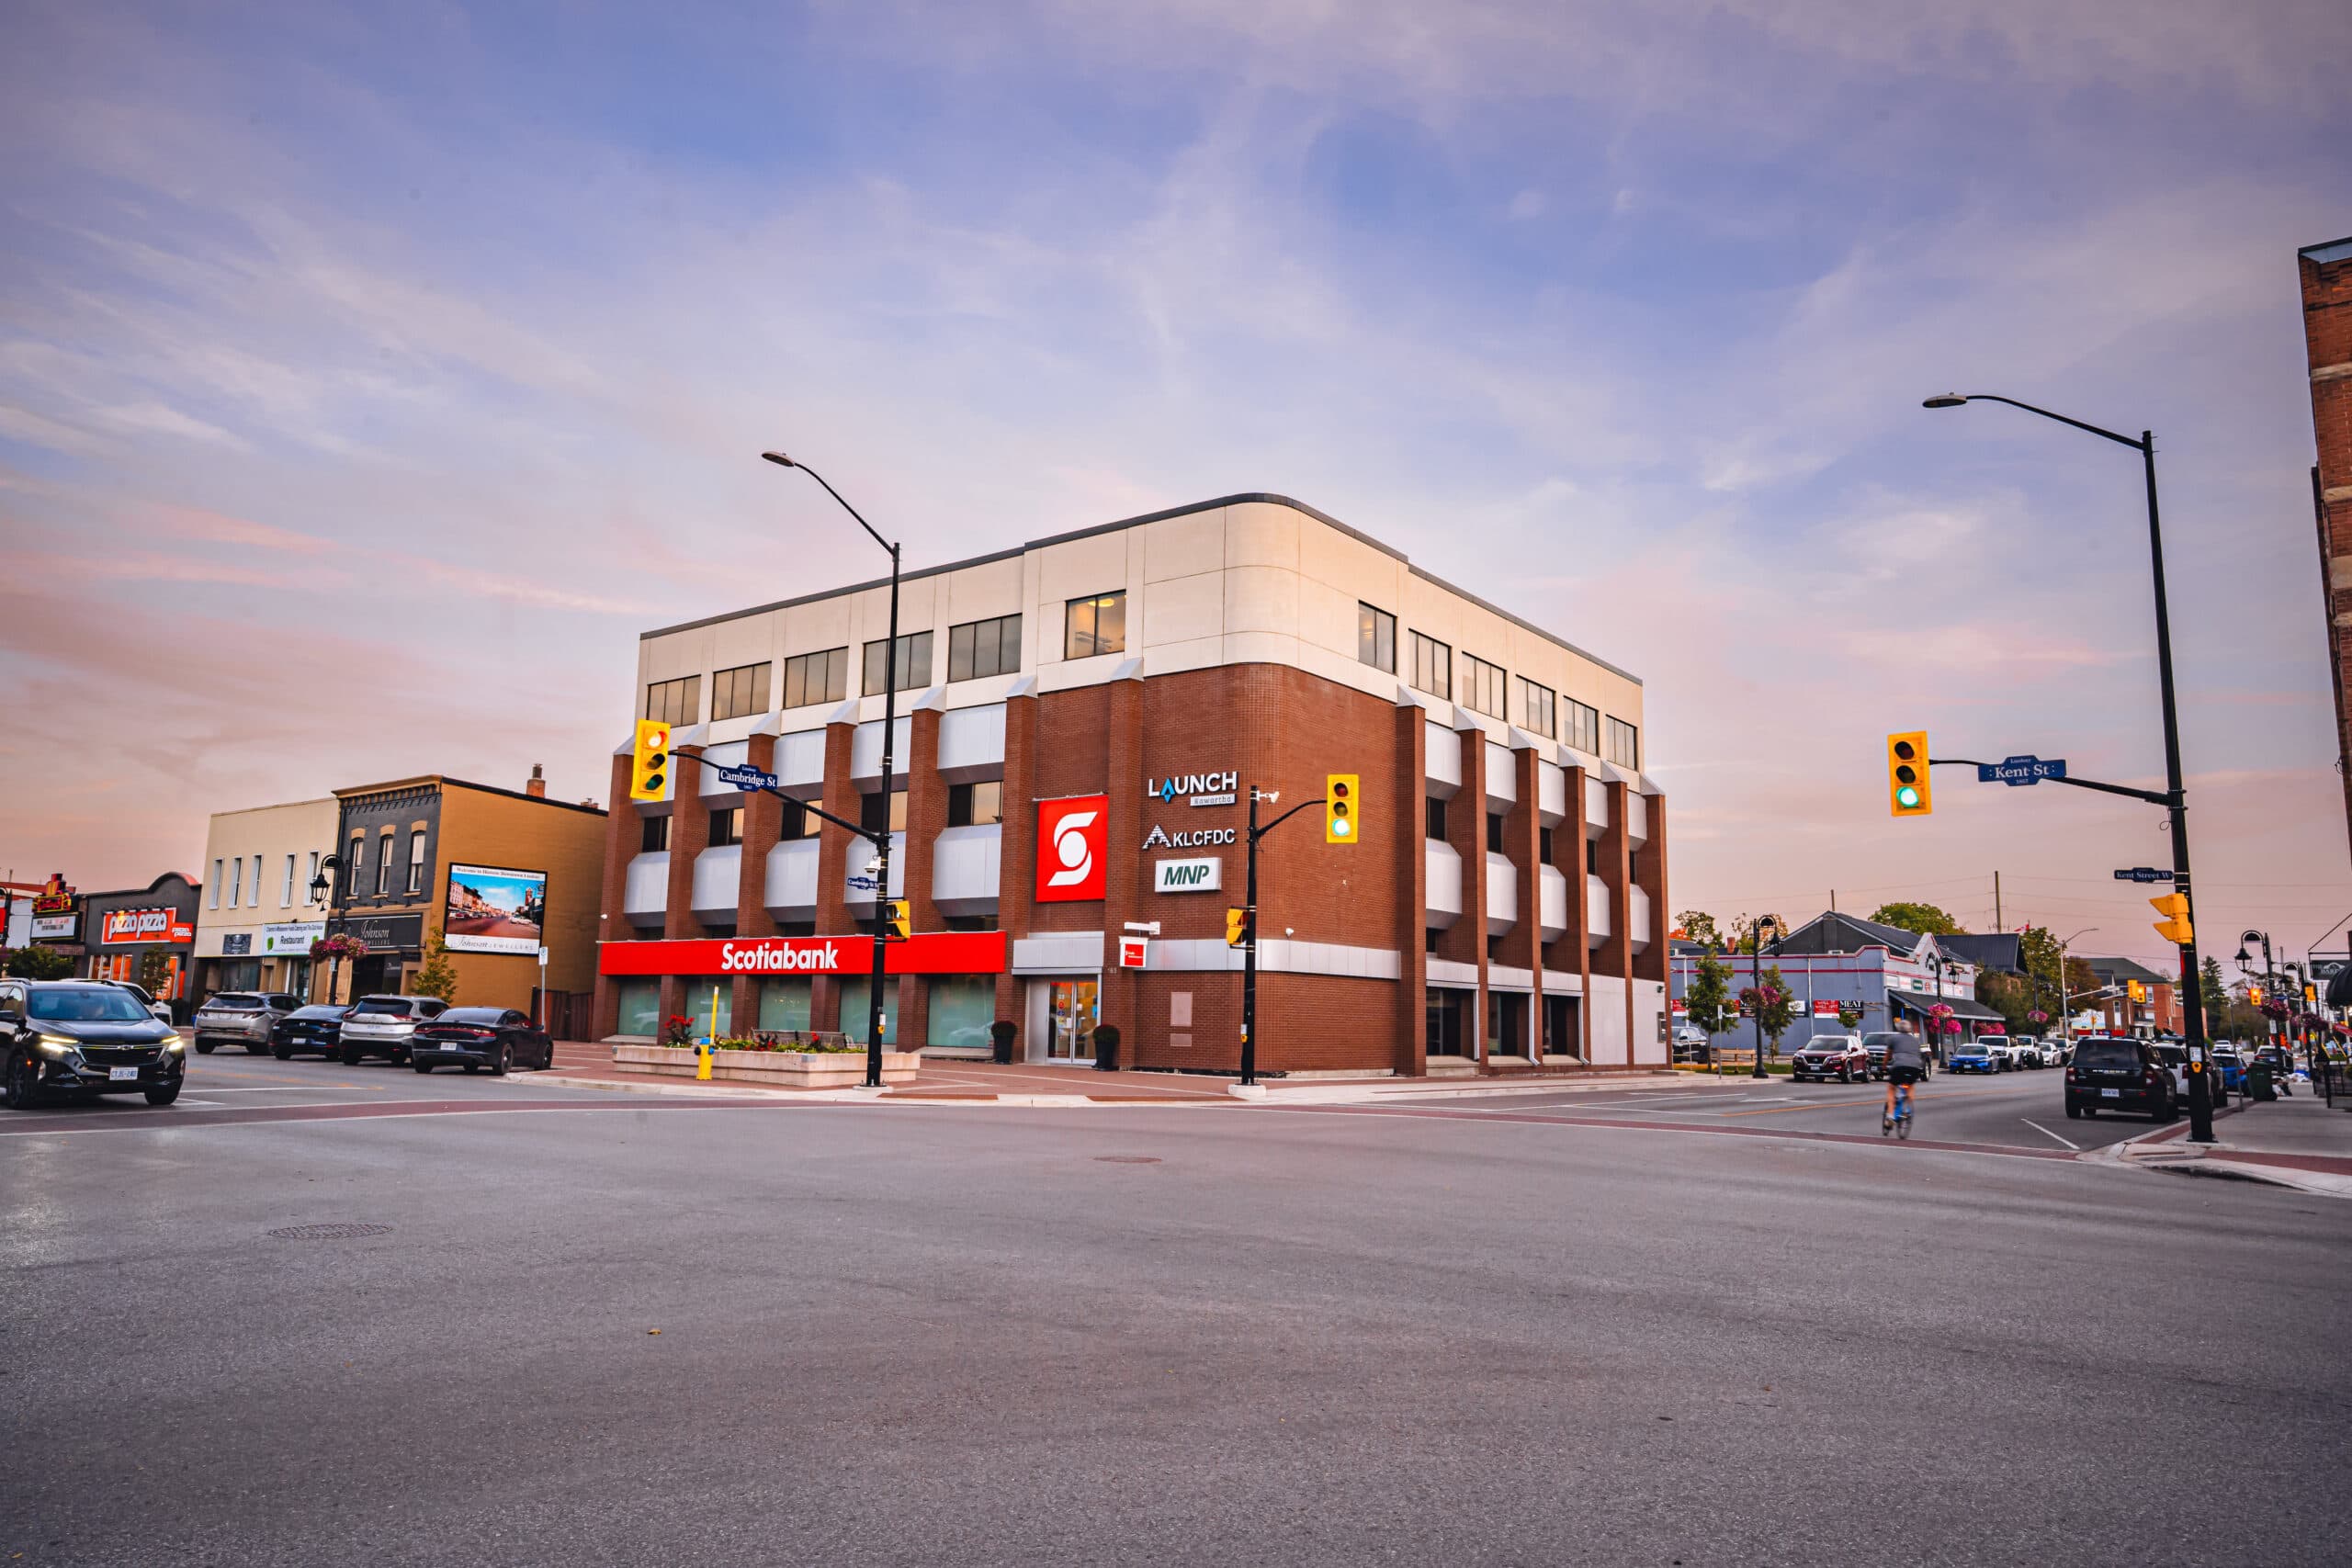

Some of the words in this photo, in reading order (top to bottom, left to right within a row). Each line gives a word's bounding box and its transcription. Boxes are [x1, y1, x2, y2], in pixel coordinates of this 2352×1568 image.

[720, 770, 764, 787] Cambridge
[766, 776, 775, 787] St
[1995, 766, 2029, 778] Kent
[2033, 764, 2050, 775] St
[1148, 772, 1238, 803] LAUNCH
[1173, 829, 1236, 847] KLCFDC
[1163, 865, 1210, 886] MNP
[108, 914, 138, 941] pizza
[136, 912, 167, 939] pizza
[360, 920, 390, 938] Johnson
[280, 935, 304, 944] Restaurant
[721, 941, 839, 970] Scotiabank
[1839, 999, 1861, 1009] MEAT
